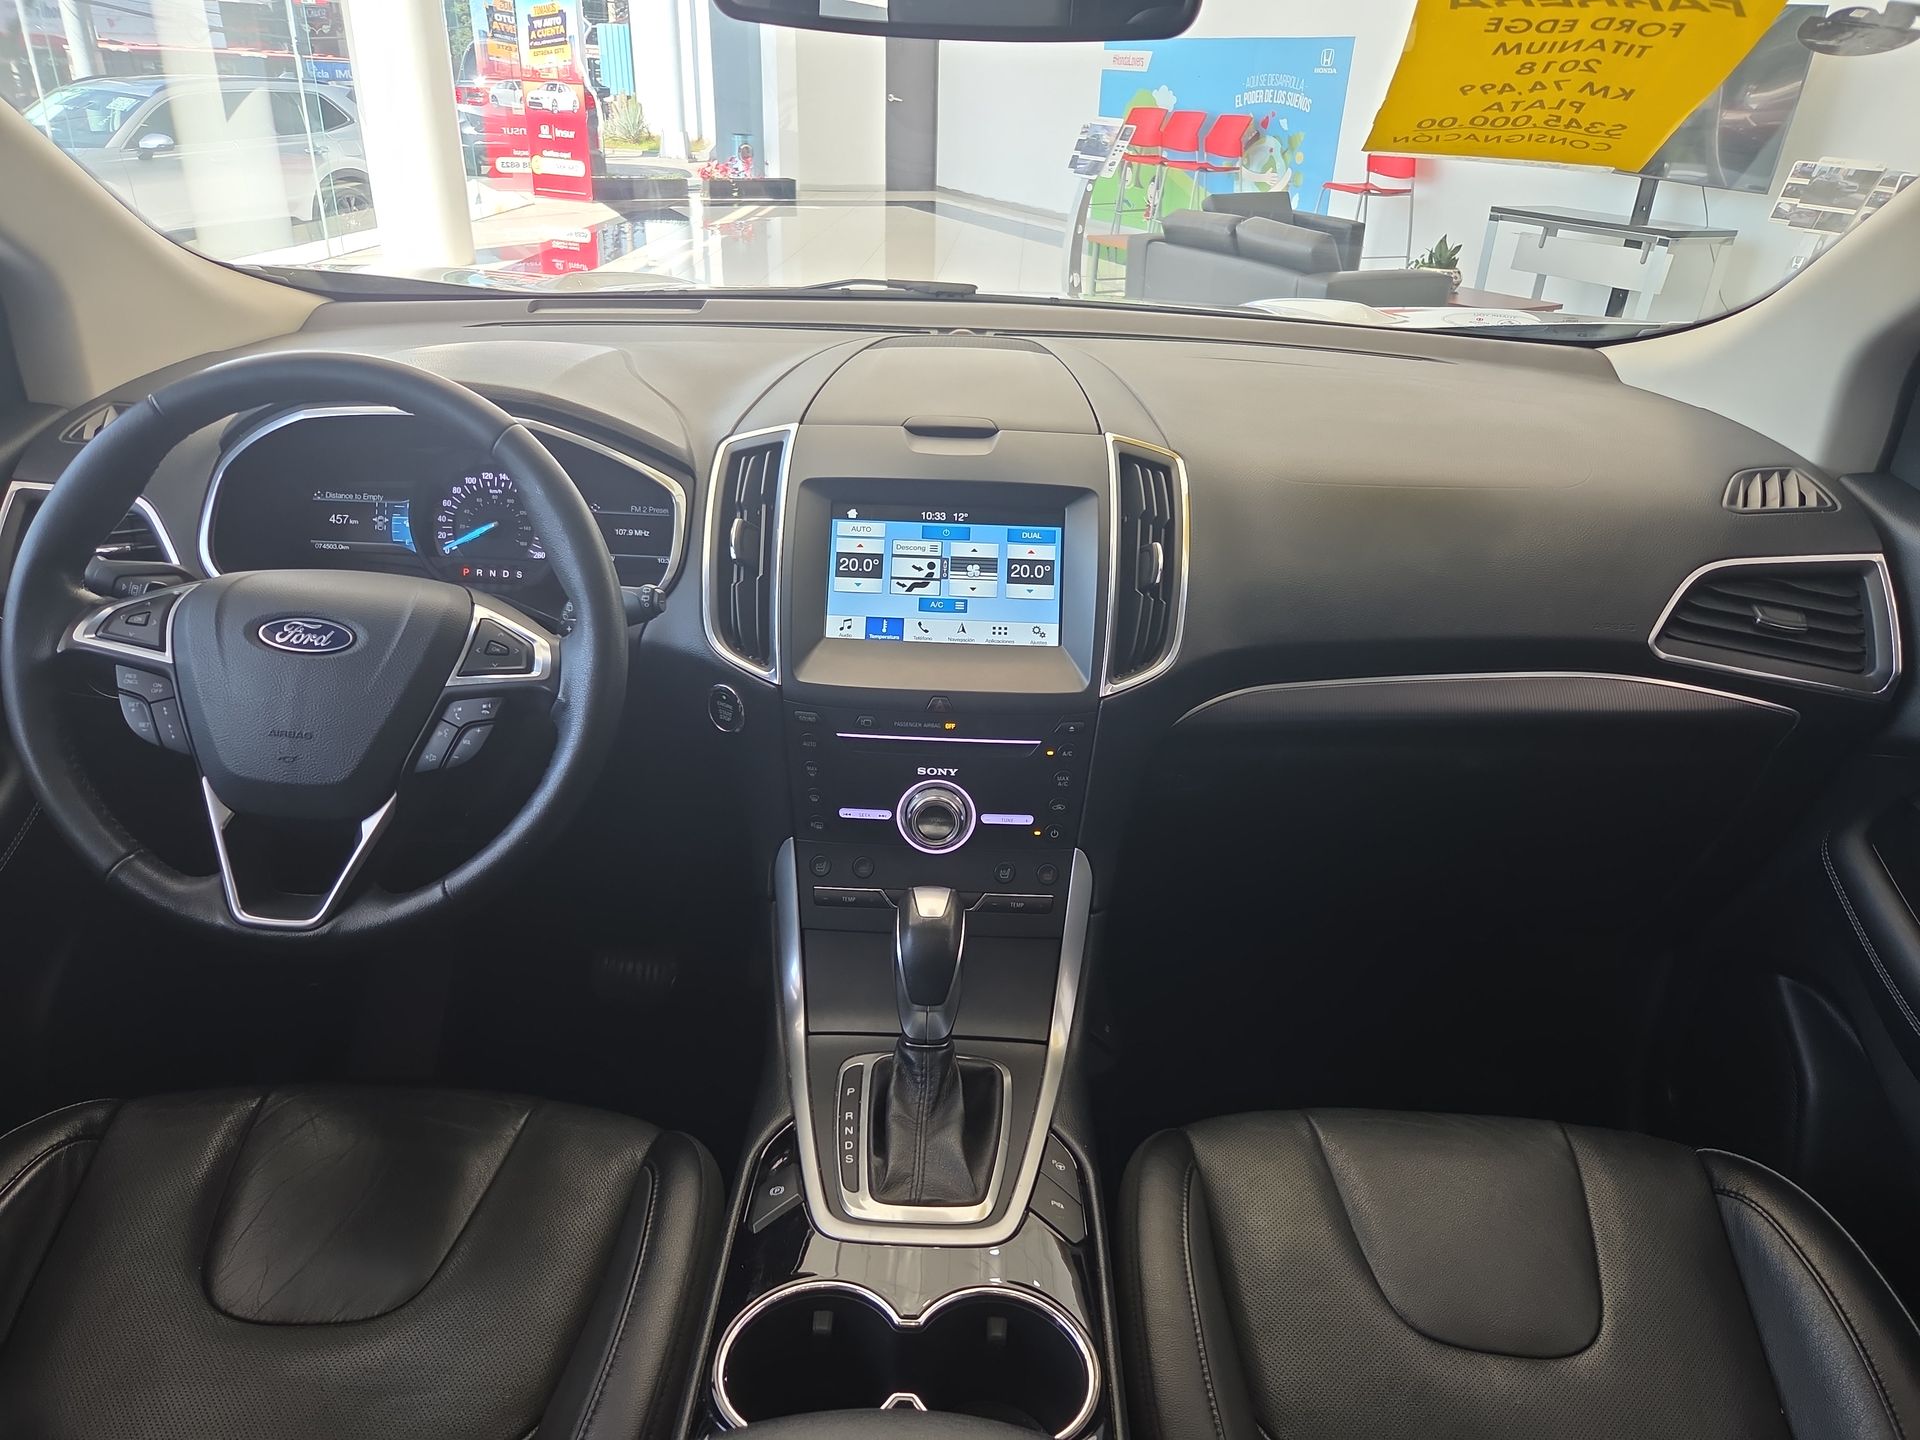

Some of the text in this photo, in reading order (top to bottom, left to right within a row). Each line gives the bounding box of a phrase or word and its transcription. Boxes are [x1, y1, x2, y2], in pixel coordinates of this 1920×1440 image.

[531, 25, 566, 40] A CUENTA
[1259, 73, 1268, 86] SE
[1267, 73, 1305, 92] DESARROLLA
[1235, 89, 1313, 113] EL PODER DE LOS SUEÑOS
[482, 472, 493, 480] 120
[465, 477, 476, 485] 100
[452, 486, 461, 494] 80
[325, 491, 354, 500] Distance
[362, 493, 384, 502] Empty
[631, 505, 642, 513] FM
[329, 514, 350, 525] 457
[921, 511, 969, 522] 10:33 12°
[615, 528, 651, 537] 107.9 MHz
[850, 525, 872, 533] AUTO
[1021, 531, 1042, 539] DUAL
[895, 543, 927, 553] Descong
[838, 557, 880, 572] 20.0°
[463, 568, 470, 576] P
[476, 569, 483, 577] R
[1010, 563, 1052, 579] 20.0°
[929, 601, 944, 609] A/C
[275, 621, 335, 647] Ford
[917, 767, 959, 776] SONY
[846, 1087, 856, 1096] P
[845, 1111, 854, 1120] R
[844, 1126, 854, 1136] N
[844, 1141, 854, 1150] D
[845, 1154, 854, 1164] S
